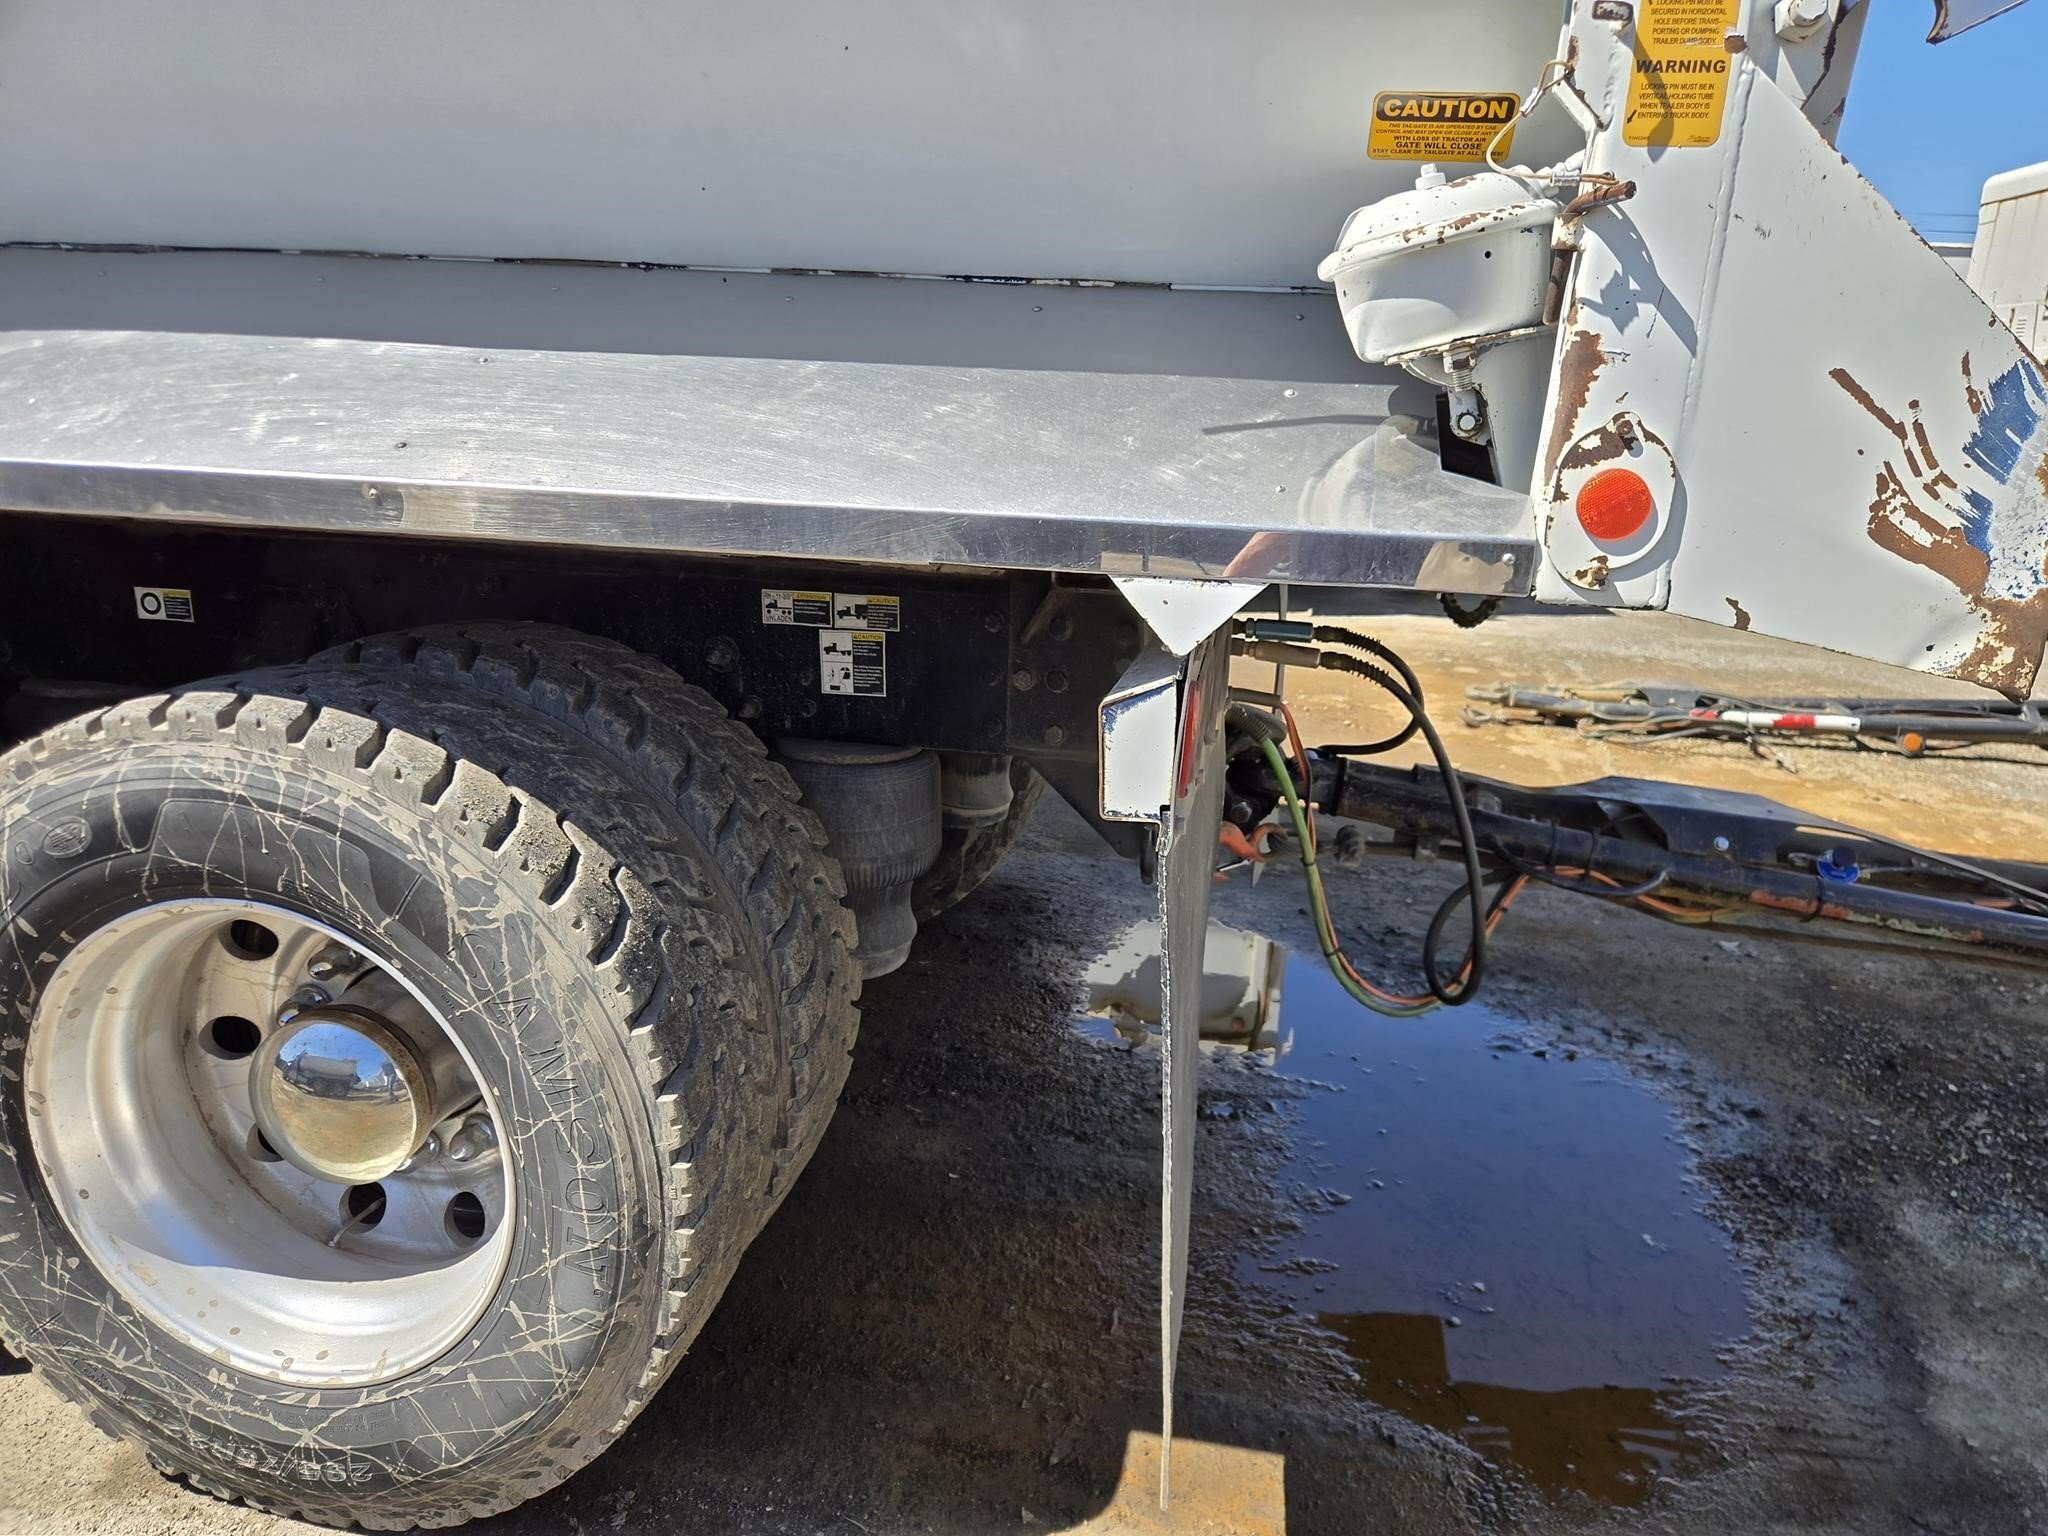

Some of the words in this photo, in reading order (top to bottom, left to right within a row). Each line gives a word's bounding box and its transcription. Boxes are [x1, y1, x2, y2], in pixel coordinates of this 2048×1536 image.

[1636, 59, 1726, 74] WARNING
[1641, 83, 1668, 91] LOCKING
[1669, 83, 1679, 91] PIN
[1680, 83, 1698, 91] MUST
[1699, 83, 1708, 91] BE
[1708, 83, 1715, 91] IN
[1383, 98, 1509, 119] CAUTION
[1640, 102, 1658, 110] WHEN
[1660, 102, 1685, 110] TRAILER
[1686, 102, 1703, 110] BODY
[1704, 102, 1711, 110] IS
[1450, 142, 1483, 150] CLOSE
[766, 614, 792, 622] UNLADEN
